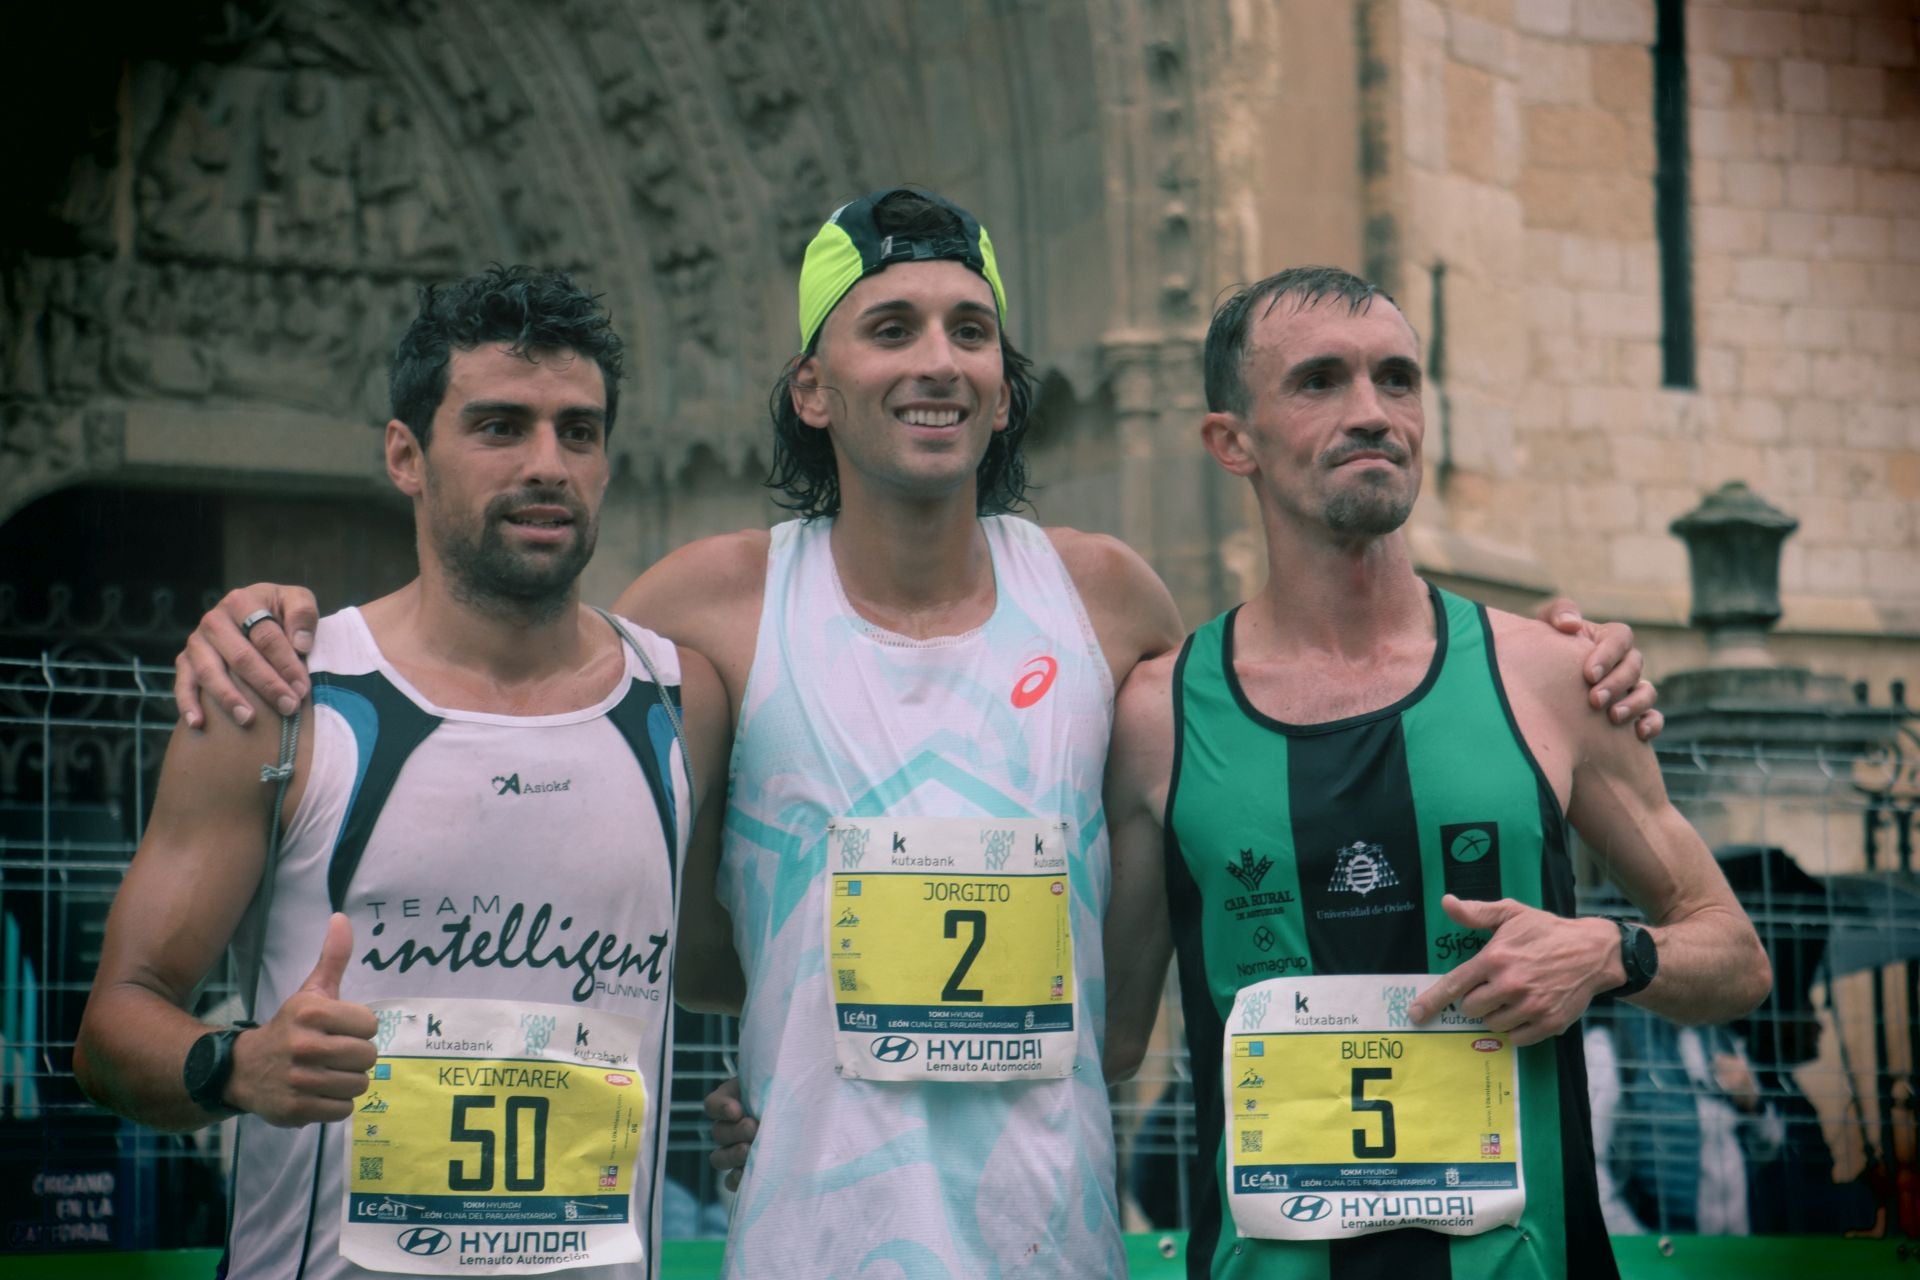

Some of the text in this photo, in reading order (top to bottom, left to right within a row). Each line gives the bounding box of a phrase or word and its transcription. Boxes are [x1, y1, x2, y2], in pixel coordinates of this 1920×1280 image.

[893, 831, 906, 854] k
[1035, 834, 1044, 855] k
[892, 856, 955, 867] kutxabank
[923, 882, 1010, 902] JORGITO
[1250, 891, 1295, 905] RURAL
[367, 896, 500, 919] TEAM
[1316, 902, 1415, 920] Universidad de Oviedo
[362, 903, 668, 1001] intelligent
[941, 909, 987, 1002] 2
[1236, 955, 1308, 977] Normagrup
[596, 981, 660, 1001] RUNNING
[1295, 991, 1309, 1013] k
[427, 1013, 442, 1037] k
[888, 1019, 1020, 1029] LEÓN CUNA DEL PARLAMENTARISMO
[1295, 1014, 1359, 1025] kutxabank
[426, 1039, 493, 1051] kutxabank
[577, 1023, 588, 1047] k
[927, 1039, 1042, 1060] HYUNDAI
[1342, 1038, 1403, 1060] BUEÑO
[926, 1060, 1042, 1072] Lemauto Automoción
[439, 1067, 571, 1089] KEVINTAREK
[1351, 1067, 1396, 1159] 5
[448, 1095, 550, 1192] 50
[1301, 1177, 1436, 1187] LEÓN CUNA DEL PARLAMENTARISMO
[1340, 1168, 1398, 1176] 10KM HYUNDAI
[420, 1211, 557, 1220] LEÓN CUNA DEL PARLAMENTARISMO
[1341, 1197, 1473, 1217] HYUNDAI
[1341, 1217, 1473, 1229] Lemauto Automoción
[460, 1231, 586, 1254] HYUNDAI
[459, 1252, 589, 1266] Lemauto Automoción
